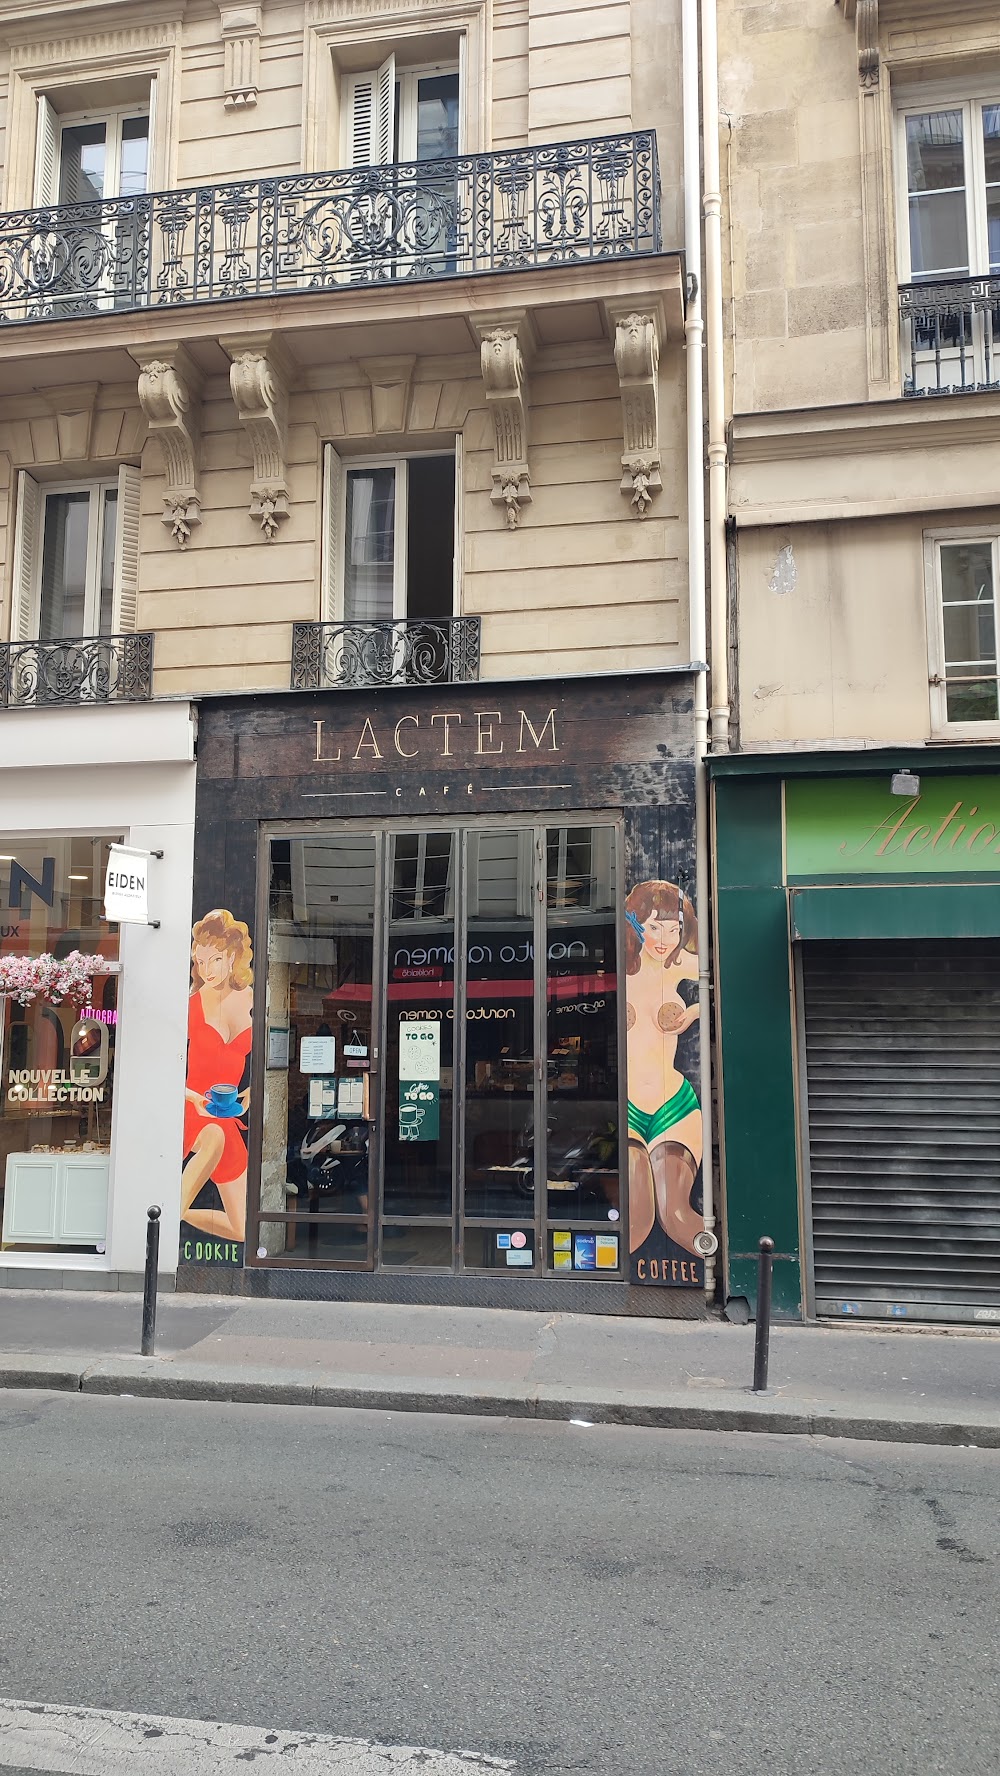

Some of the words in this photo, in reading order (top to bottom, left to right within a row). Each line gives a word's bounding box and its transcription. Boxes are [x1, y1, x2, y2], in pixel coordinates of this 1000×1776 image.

[312, 708, 560, 762] LACTEM
[395, 783, 474, 797] CAFÉ
[837, 795, 1000, 857] Actio
[0, 857, 55, 908] N
[108, 872, 145, 891] EIDEN
[8, 1069, 90, 1085] NOUVELLE
[7, 1086, 104, 1102] COLLECTION
[404, 1092, 418, 1101] TO
[419, 1092, 434, 1101] GO
[184, 1240, 239, 1263] COOKIE
[637, 1258, 700, 1283] COFFEE
